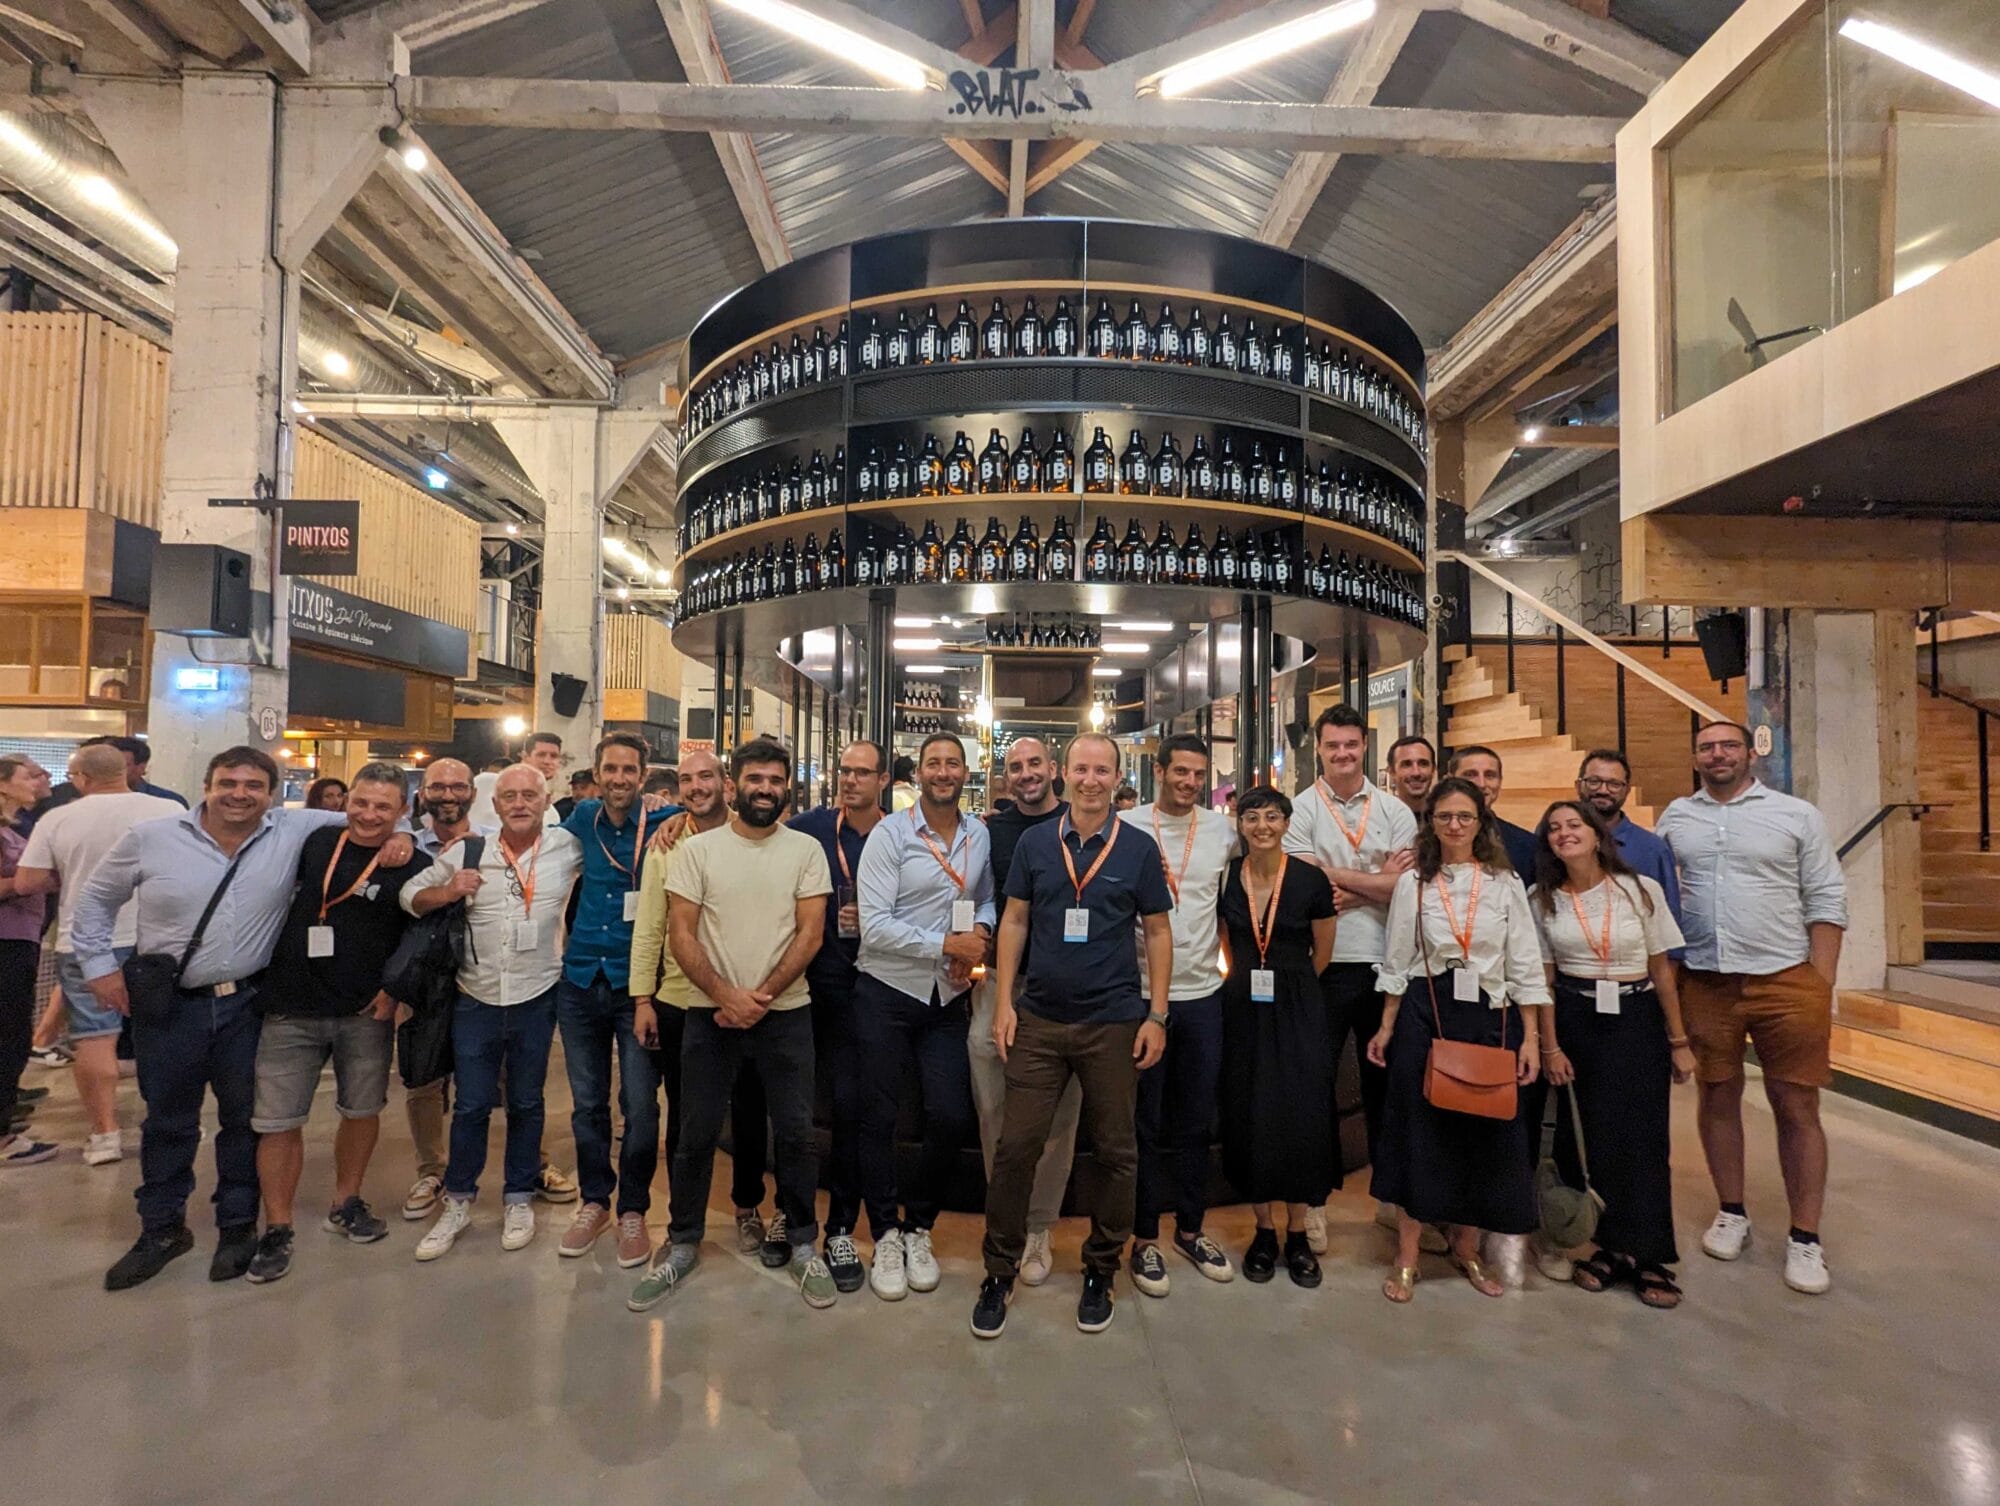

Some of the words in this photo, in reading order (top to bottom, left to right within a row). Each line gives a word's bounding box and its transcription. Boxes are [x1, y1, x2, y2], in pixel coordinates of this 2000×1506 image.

[889, 341, 900, 358] B
[1169, 334, 1179, 351] B
[1224, 345, 1235, 362] B
[1282, 355, 1292, 371] B
[920, 464, 931, 481] B
[949, 466, 961, 483] B
[981, 462, 993, 479] B
[1017, 464, 1029, 480] B
[1053, 462, 1065, 479] B
[1094, 462, 1105, 479] B
[1134, 463, 1146, 480] B
[1160, 466, 1172, 484] B
[1200, 469, 1211, 486] B
[860, 471, 871, 488] B
[888, 471, 900, 488] B
[1232, 473, 1241, 490] B
[1259, 477, 1269, 494] B
[1282, 482, 1293, 499] B
[287, 526, 350, 547] PINTXOS
[888, 554, 899, 571] B
[949, 553, 960, 570] B
[983, 553, 996, 570] B
[1014, 552, 1027, 569] B
[1053, 553, 1066, 569] B
[1094, 553, 1107, 570] B
[1133, 553, 1145, 571] B
[1165, 554, 1177, 571] B
[1196, 556, 1207, 573] B
[1223, 558, 1235, 575] B
[1250, 561, 1262, 578] B
[1275, 563, 1287, 580] B
[1757, 733, 1769, 748] 06
